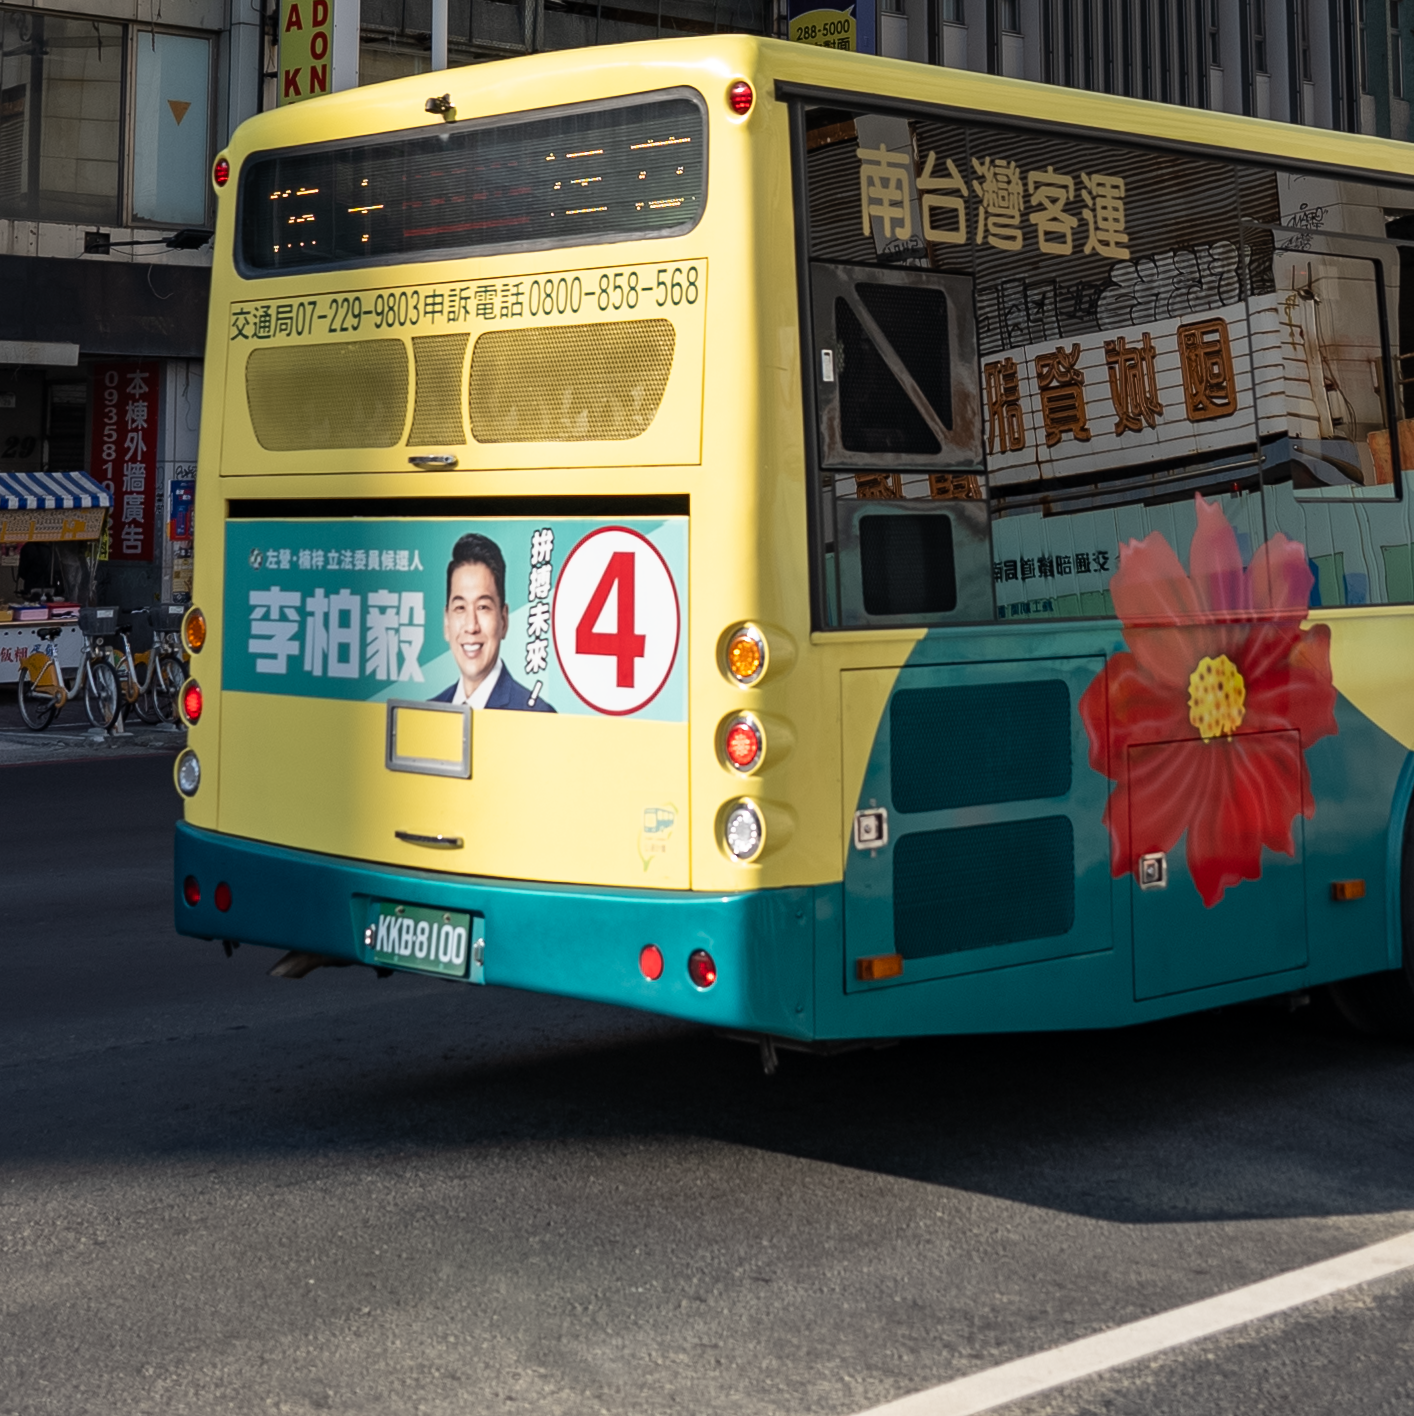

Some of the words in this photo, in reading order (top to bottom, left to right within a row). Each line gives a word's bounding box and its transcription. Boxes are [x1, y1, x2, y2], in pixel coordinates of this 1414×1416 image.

[796, 18, 851, 41] 288-5000
[856, 142, 1131, 260] 南台灣客運
[1, 435, 36, 459] 29
[247, 585, 426, 683] 李柏毅
[574, 550, 647, 689] 4
[374, 913, 467, 966] KKB-8100
